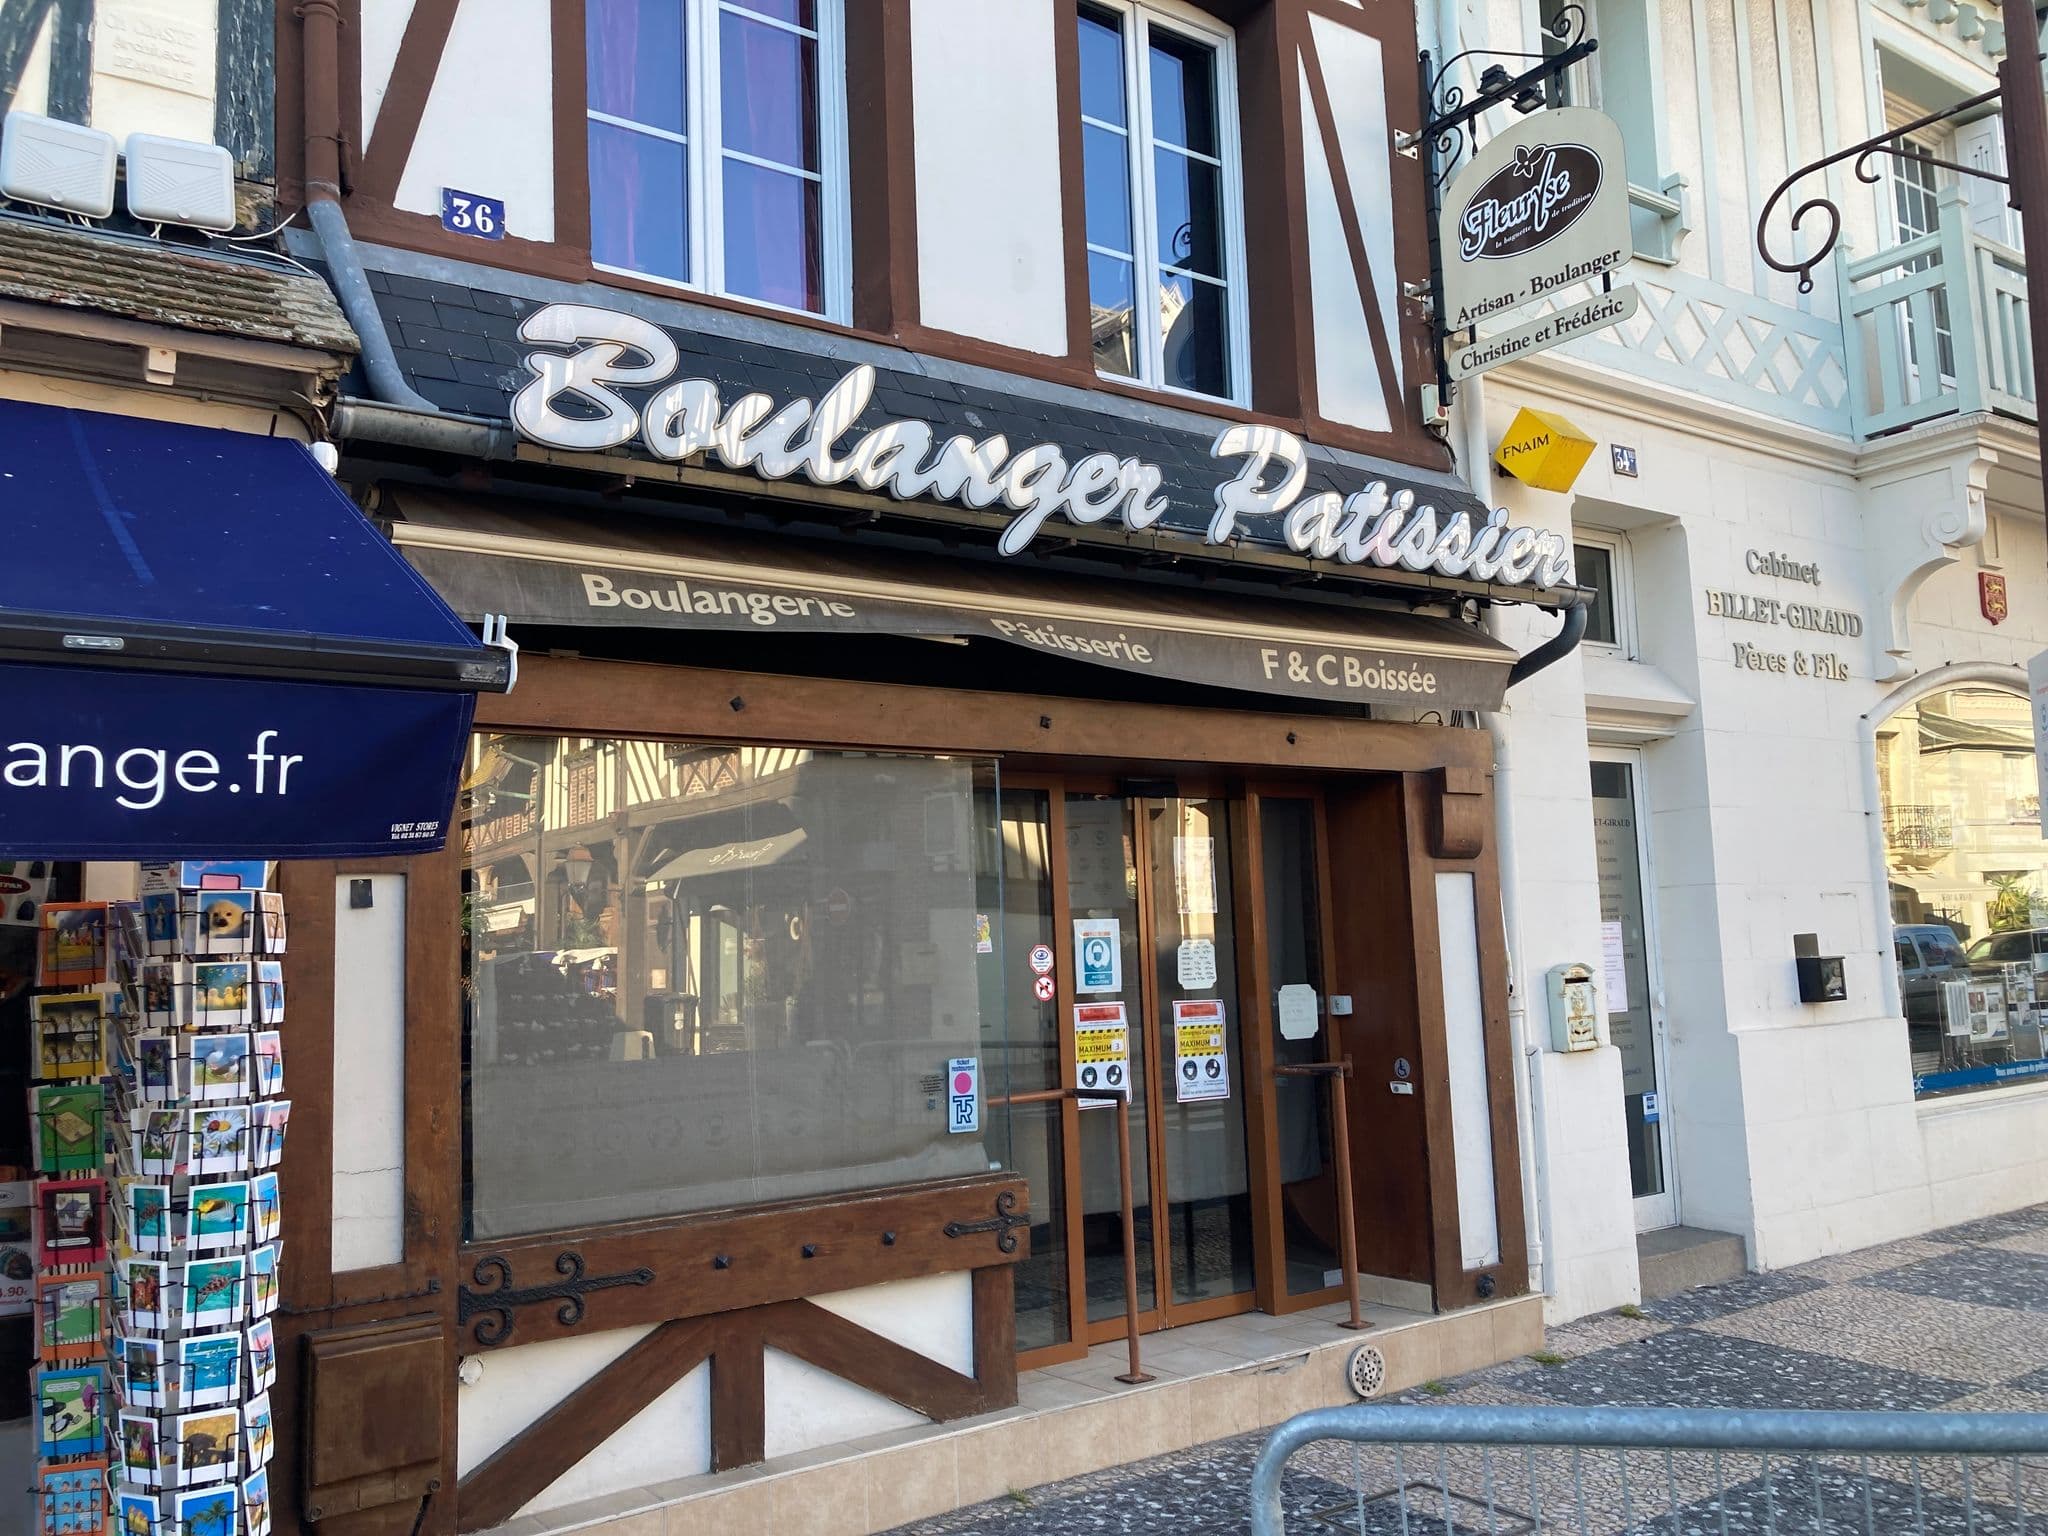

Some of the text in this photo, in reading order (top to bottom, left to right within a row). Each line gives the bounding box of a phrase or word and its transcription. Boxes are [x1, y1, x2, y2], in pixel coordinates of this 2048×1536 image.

[452, 197, 494, 233] 36
[1504, 225, 1533, 245] baguette
[1551, 207, 1560, 217] de
[1561, 192, 1592, 213] tradition
[1457, 291, 1515, 325] Artisan
[1530, 249, 1621, 296] Boulanger
[1460, 298, 1624, 371] Christine et Frédéric
[510, 303, 1569, 588] Boulanger Patissier
[1503, 433, 1549, 459] FNAIM
[1746, 549, 1821, 586] Cabinet
[581, 573, 1436, 694] Boulangerie Pâtisserie F & C Boissée
[1706, 589, 1864, 638] BILLET-GIRAUD
[1733, 641, 1849, 682] Pères & Fils
[3, 730, 303, 810] ange.fr
[416, 821, 440, 831] STORES
[1079, 1044, 1112, 1054] MAXIMUM
[1180, 1039, 1211, 1048] MAXIMUM
